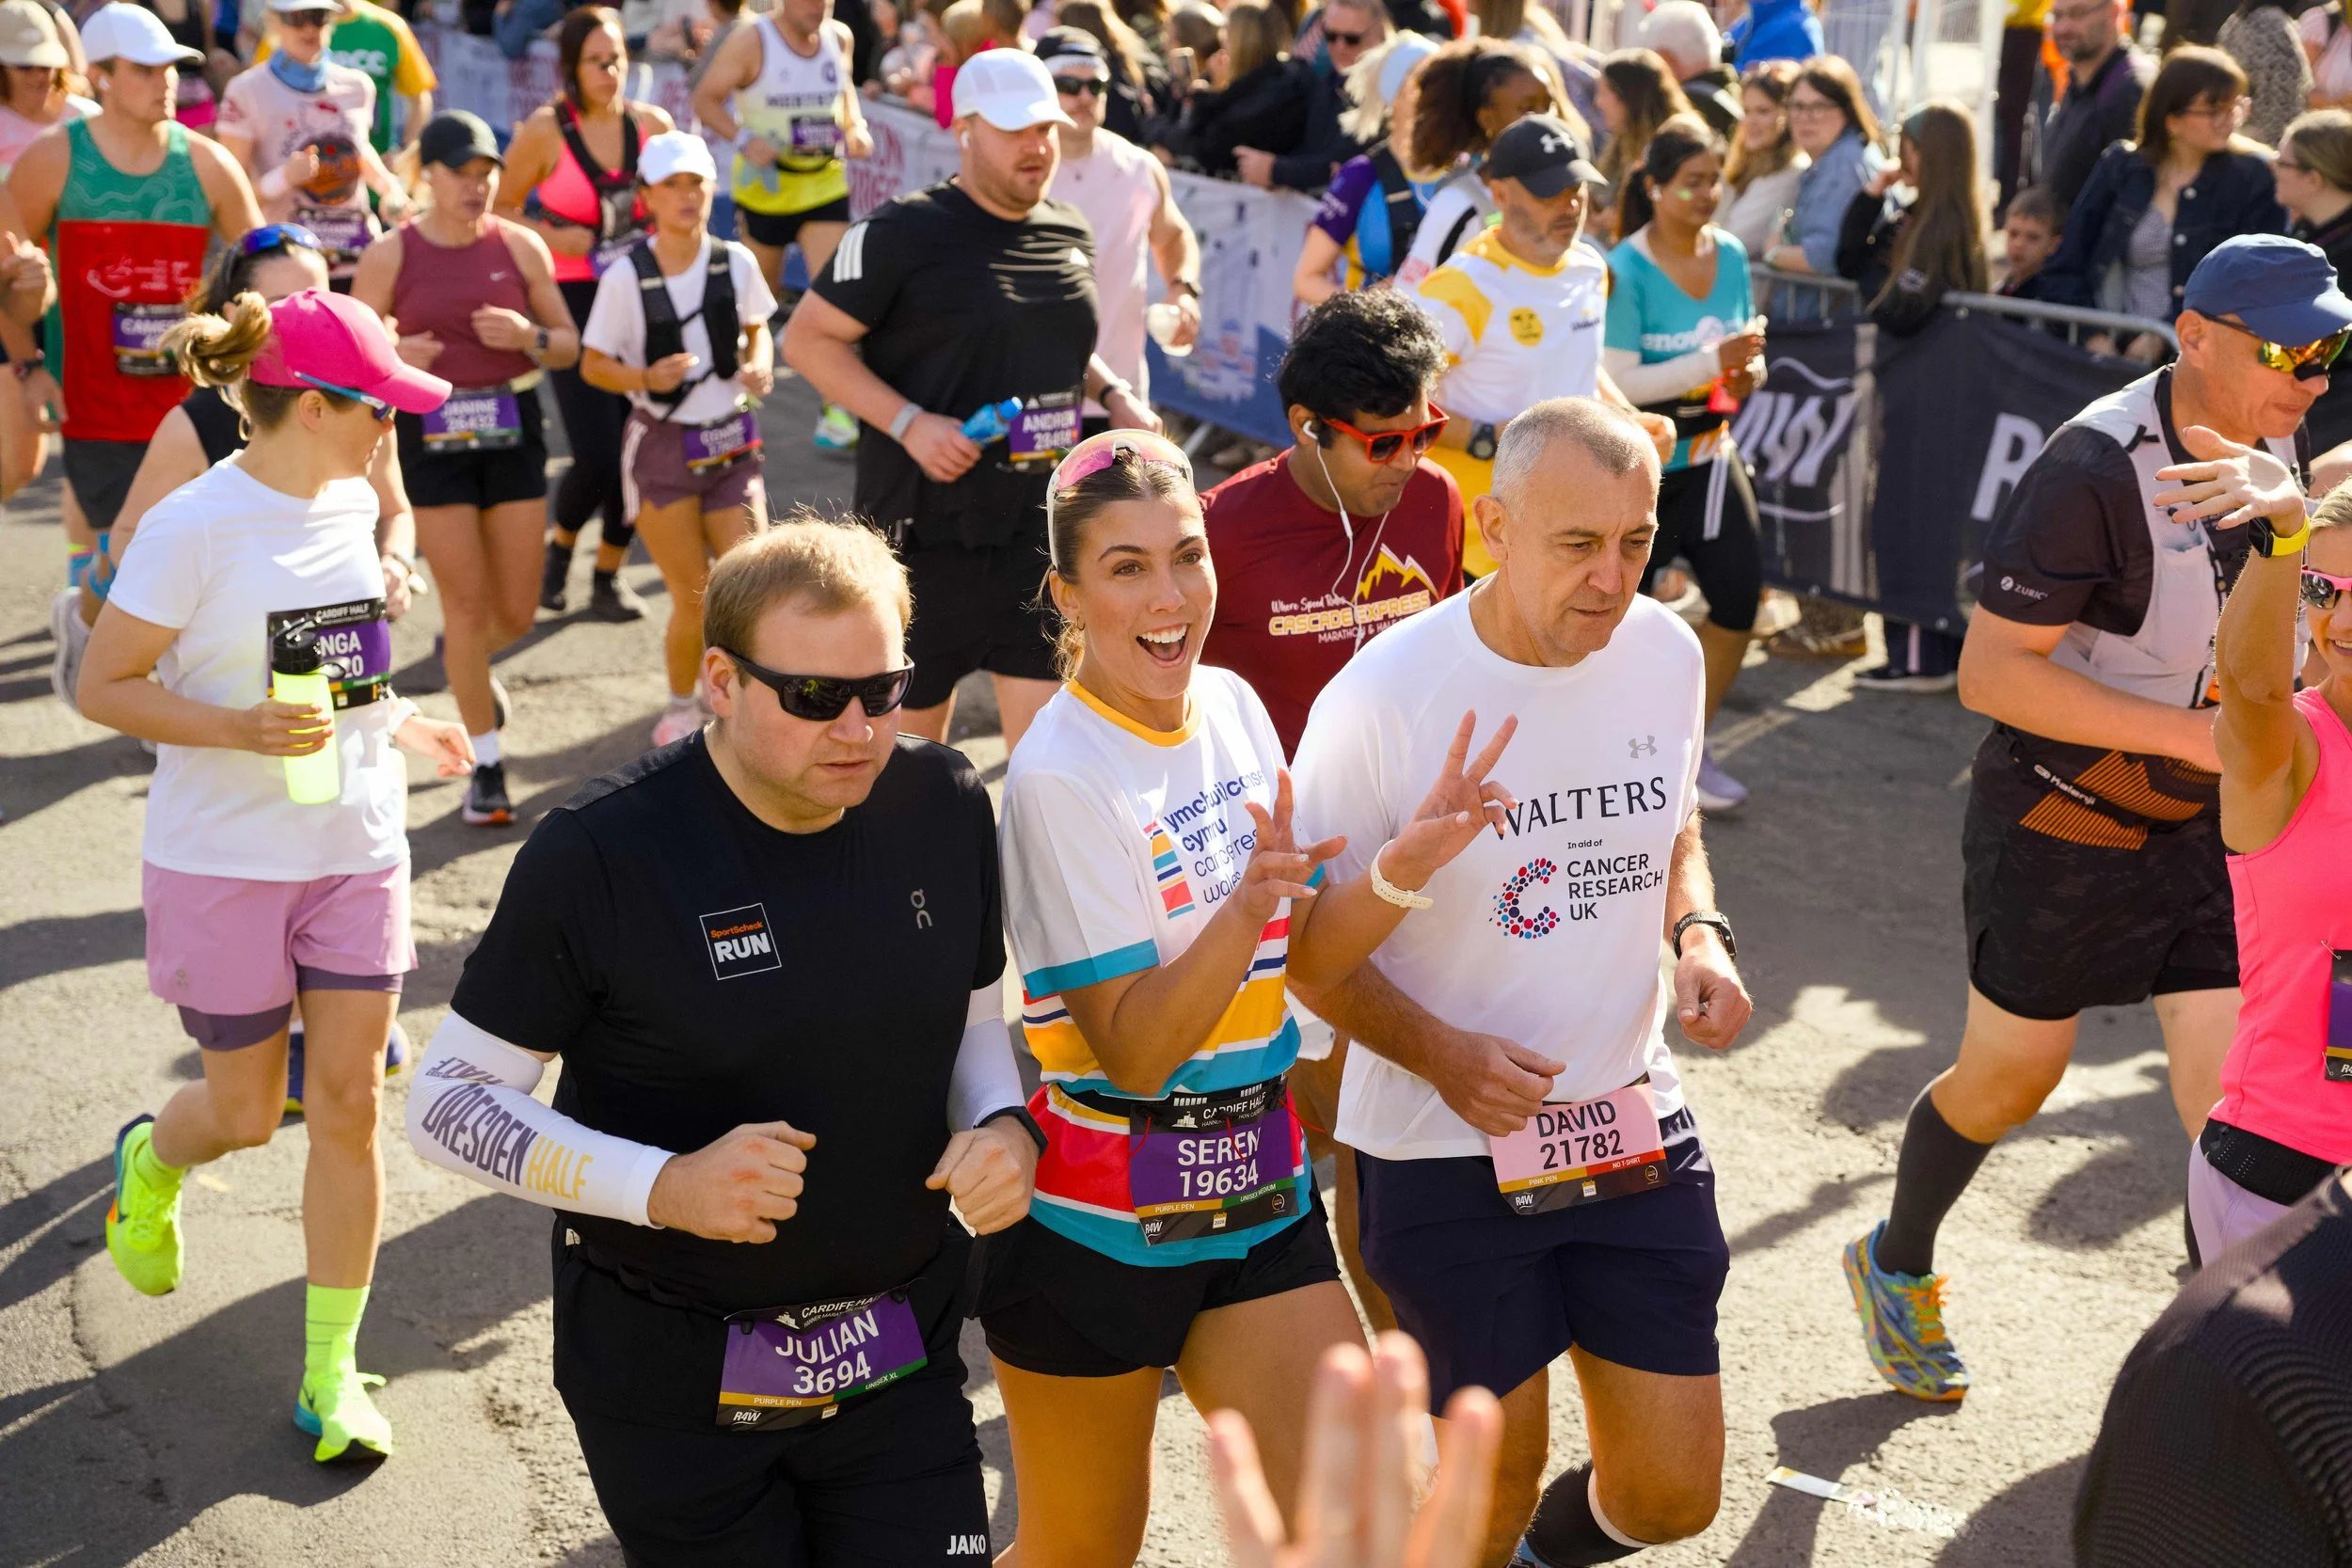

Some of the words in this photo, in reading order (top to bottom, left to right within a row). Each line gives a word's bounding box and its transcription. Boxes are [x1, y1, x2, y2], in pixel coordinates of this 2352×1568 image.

[316, 606, 349, 619] CARDIFF
[350, 603, 369, 614] HALF
[1268, 607, 1354, 636] CASCADE
[1354, 589, 1431, 624] EXPRESS
[1182, 817, 1228, 852] cymru
[1578, 840, 1592, 848] aid
[1566, 853, 1649, 878] CANCER
[1568, 869, 1664, 899] RESEARCH
[1569, 902, 1598, 921] UK
[710, 921, 764, 939] SportScheck
[714, 932, 771, 963] RUN
[1249, 1092, 1266, 1110] HALF
[1536, 1101, 1616, 1138] DAVID
[1178, 1127, 1261, 1166] SEREN
[1539, 1129, 1624, 1170] 21782
[1612, 1161, 1620, 1169] NO
[1622, 1157, 1641, 1166] T-SHIRT
[1180, 1159, 1259, 1197] 19634
[1528, 1178, 1544, 1186] PINK
[1545, 1175, 1558, 1183] PEN
[1240, 1193, 1258, 1202] UNISEX
[802, 1300, 855, 1318] CARDIFF
[775, 1309, 880, 1365] JULIAN
[793, 1351, 871, 1394] 3694
[866, 1375, 888, 1390] UNISEX
[754, 1397, 784, 1405] PURPLE
[733, 1411, 761, 1422] R4W
[946, 1534, 986, 1555] JAKO
